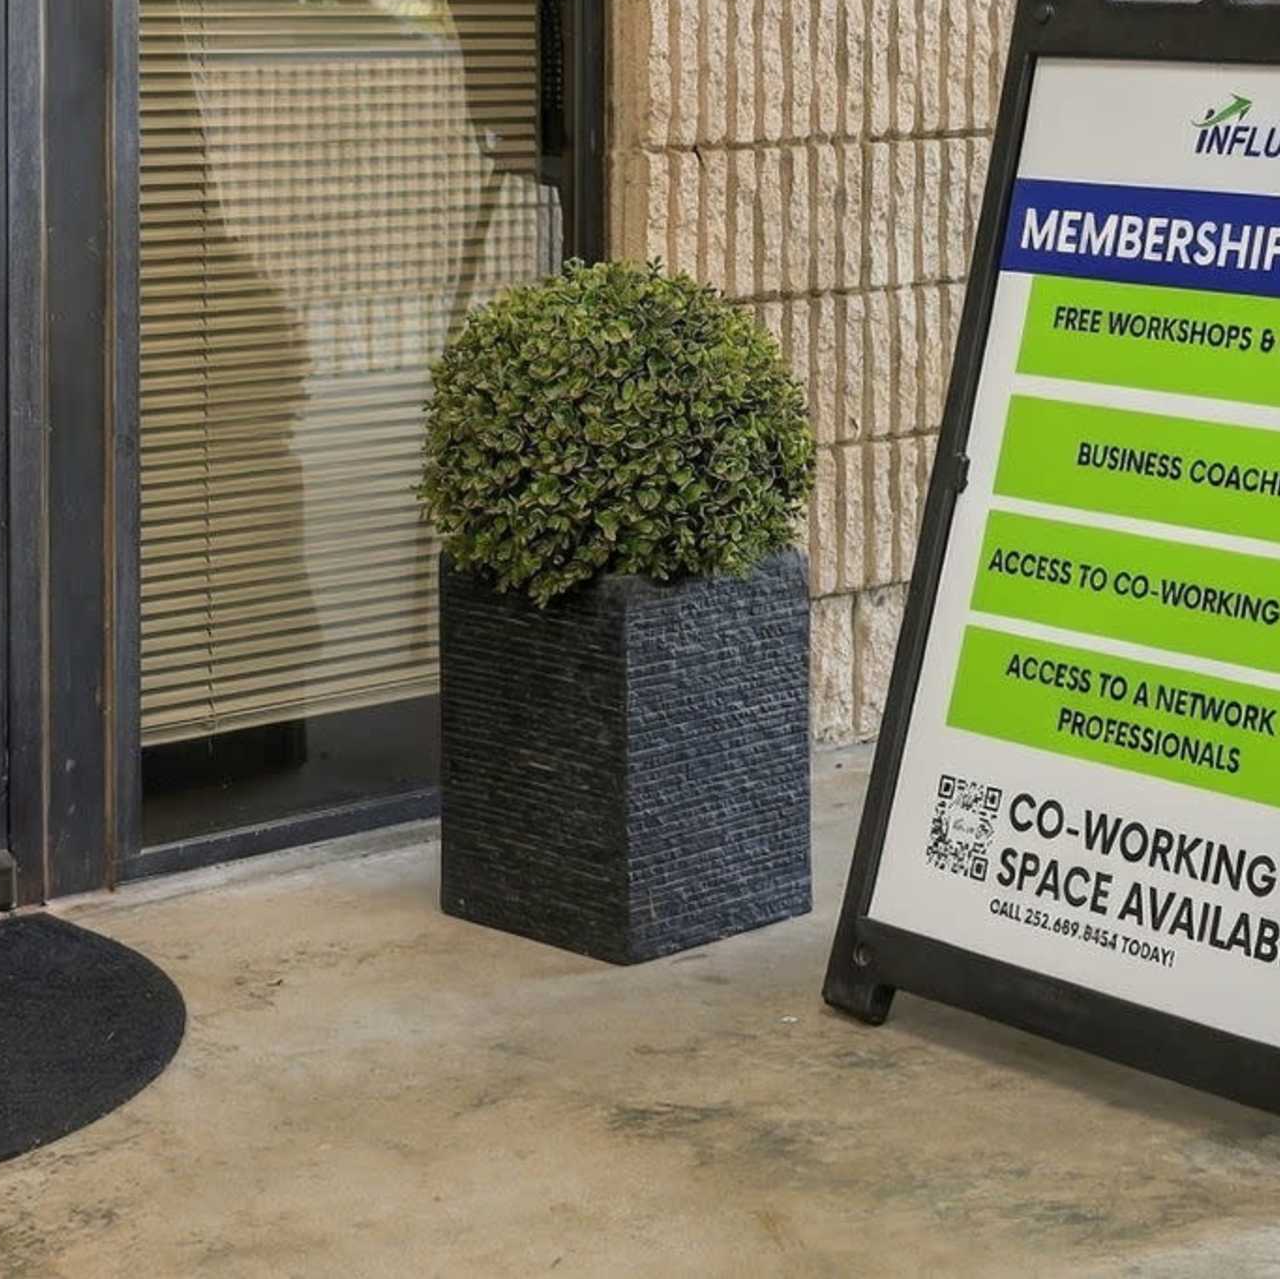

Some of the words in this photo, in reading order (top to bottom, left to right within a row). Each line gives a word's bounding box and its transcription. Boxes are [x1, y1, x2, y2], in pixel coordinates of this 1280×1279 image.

[1053, 306, 1102, 333] FREE
[1108, 312, 1252, 352] WORKSHOPS
[1261, 328, 1275, 352] &
[1077, 442, 1182, 481] BUSINESS
[988, 548, 1072, 585] ACCESS
[1079, 565, 1107, 592] TO
[1114, 570, 1280, 626] CO-WORKING
[1006, 653, 1091, 693] ACCESS
[1099, 674, 1126, 701] TO
[1133, 682, 1150, 708] A
[1156, 684, 1275, 736] NETWORK
[1057, 707, 1241, 773] PROFESSIONALS
[1009, 792, 1277, 898] CO-WORKING
[996, 847, 1114, 915] SPACE
[989, 897, 1022, 922] CALL
[1122, 935, 1175, 968] TODAY!
